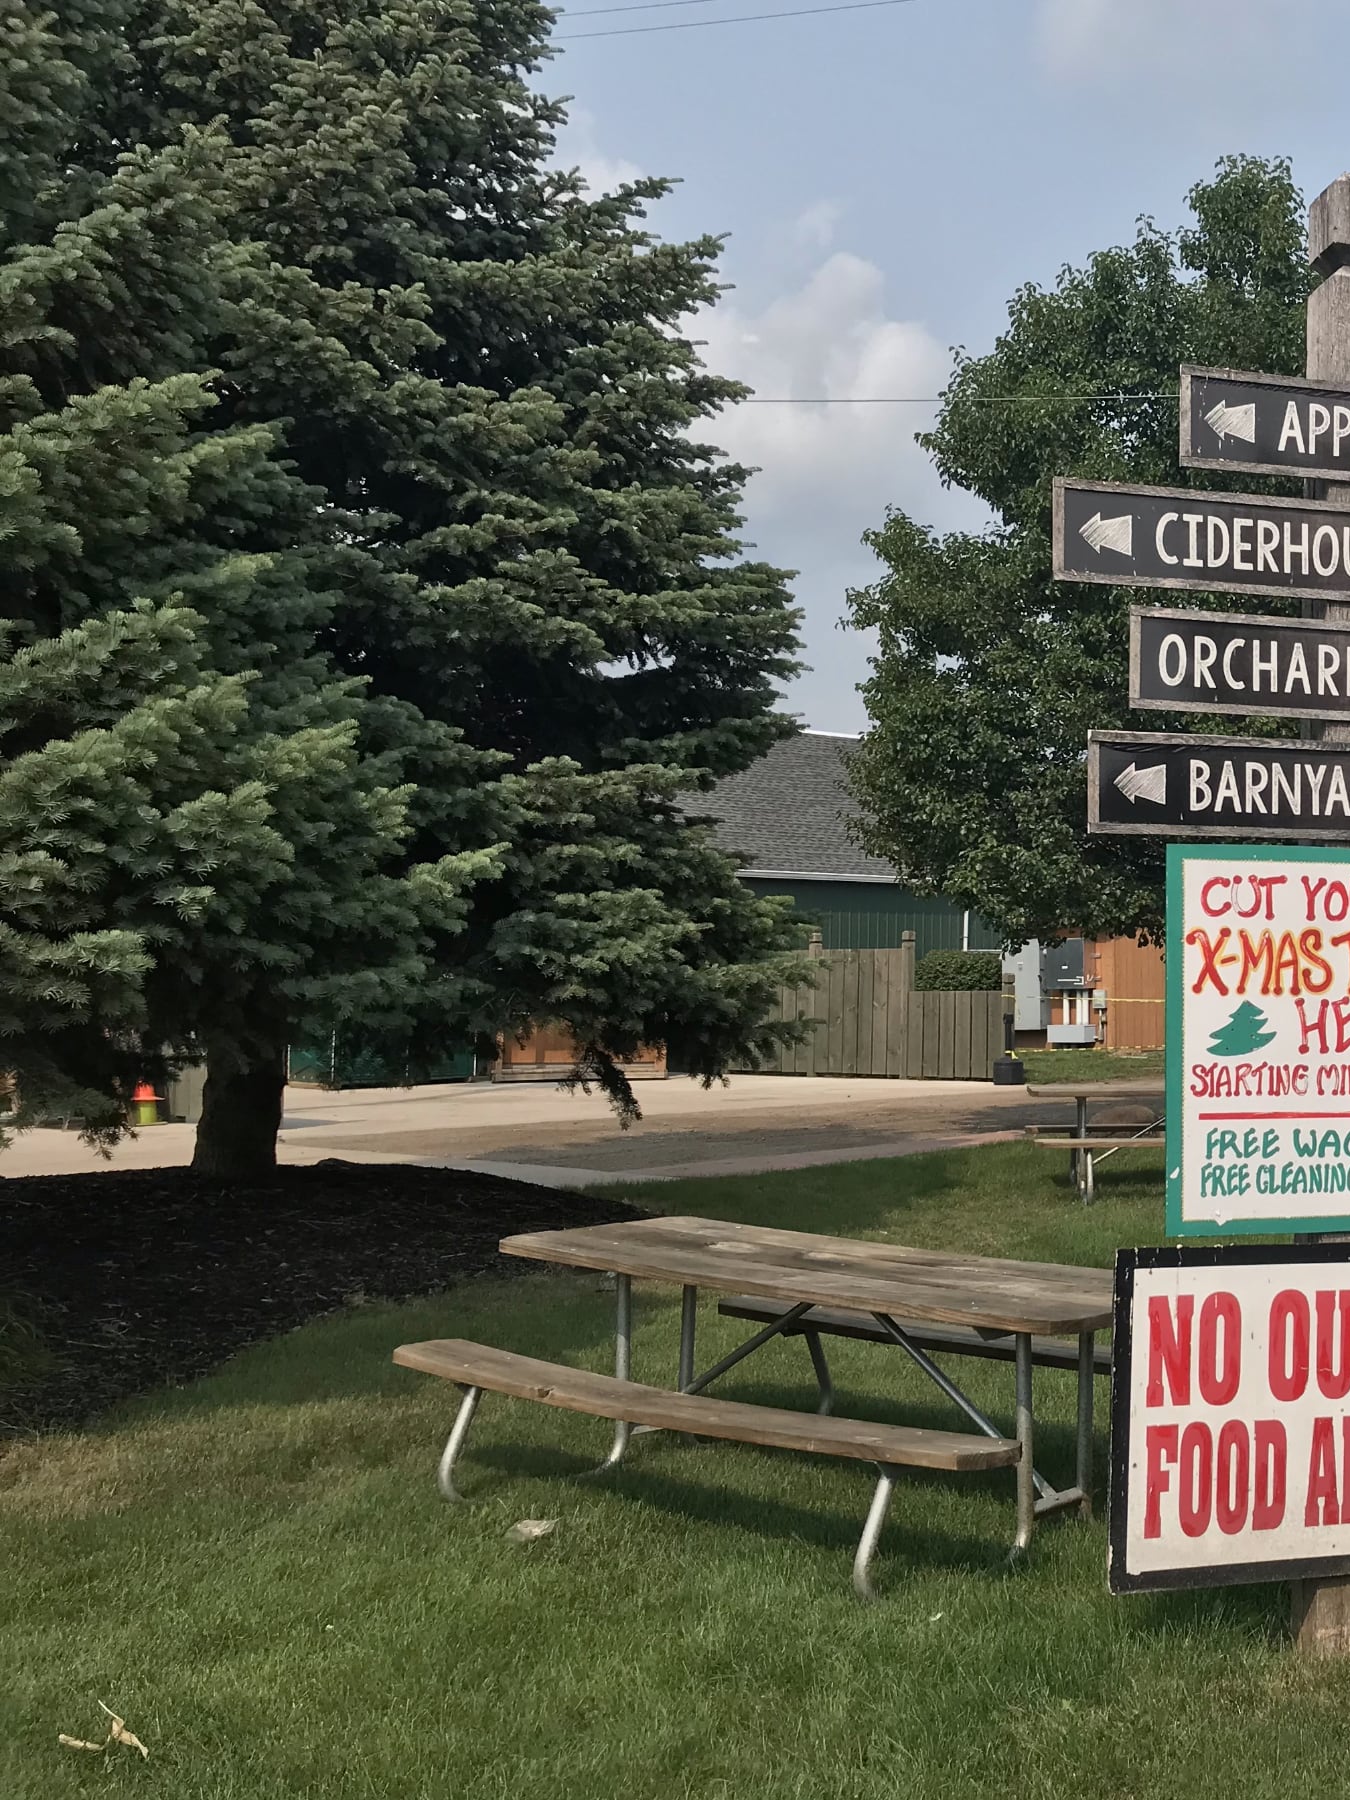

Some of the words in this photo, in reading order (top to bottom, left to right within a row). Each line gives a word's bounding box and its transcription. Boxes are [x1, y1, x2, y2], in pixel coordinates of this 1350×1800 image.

[1200, 874, 1288, 920] CUT
[1185, 926, 1335, 998] X-MAS
[1190, 1061, 1309, 1097] STARTING
[1205, 1127, 1280, 1160] FREE
[1200, 1162, 1251, 1198] FREE
[1146, 1291, 1242, 1408] NO
[1143, 1419, 1287, 1540] FOOD
